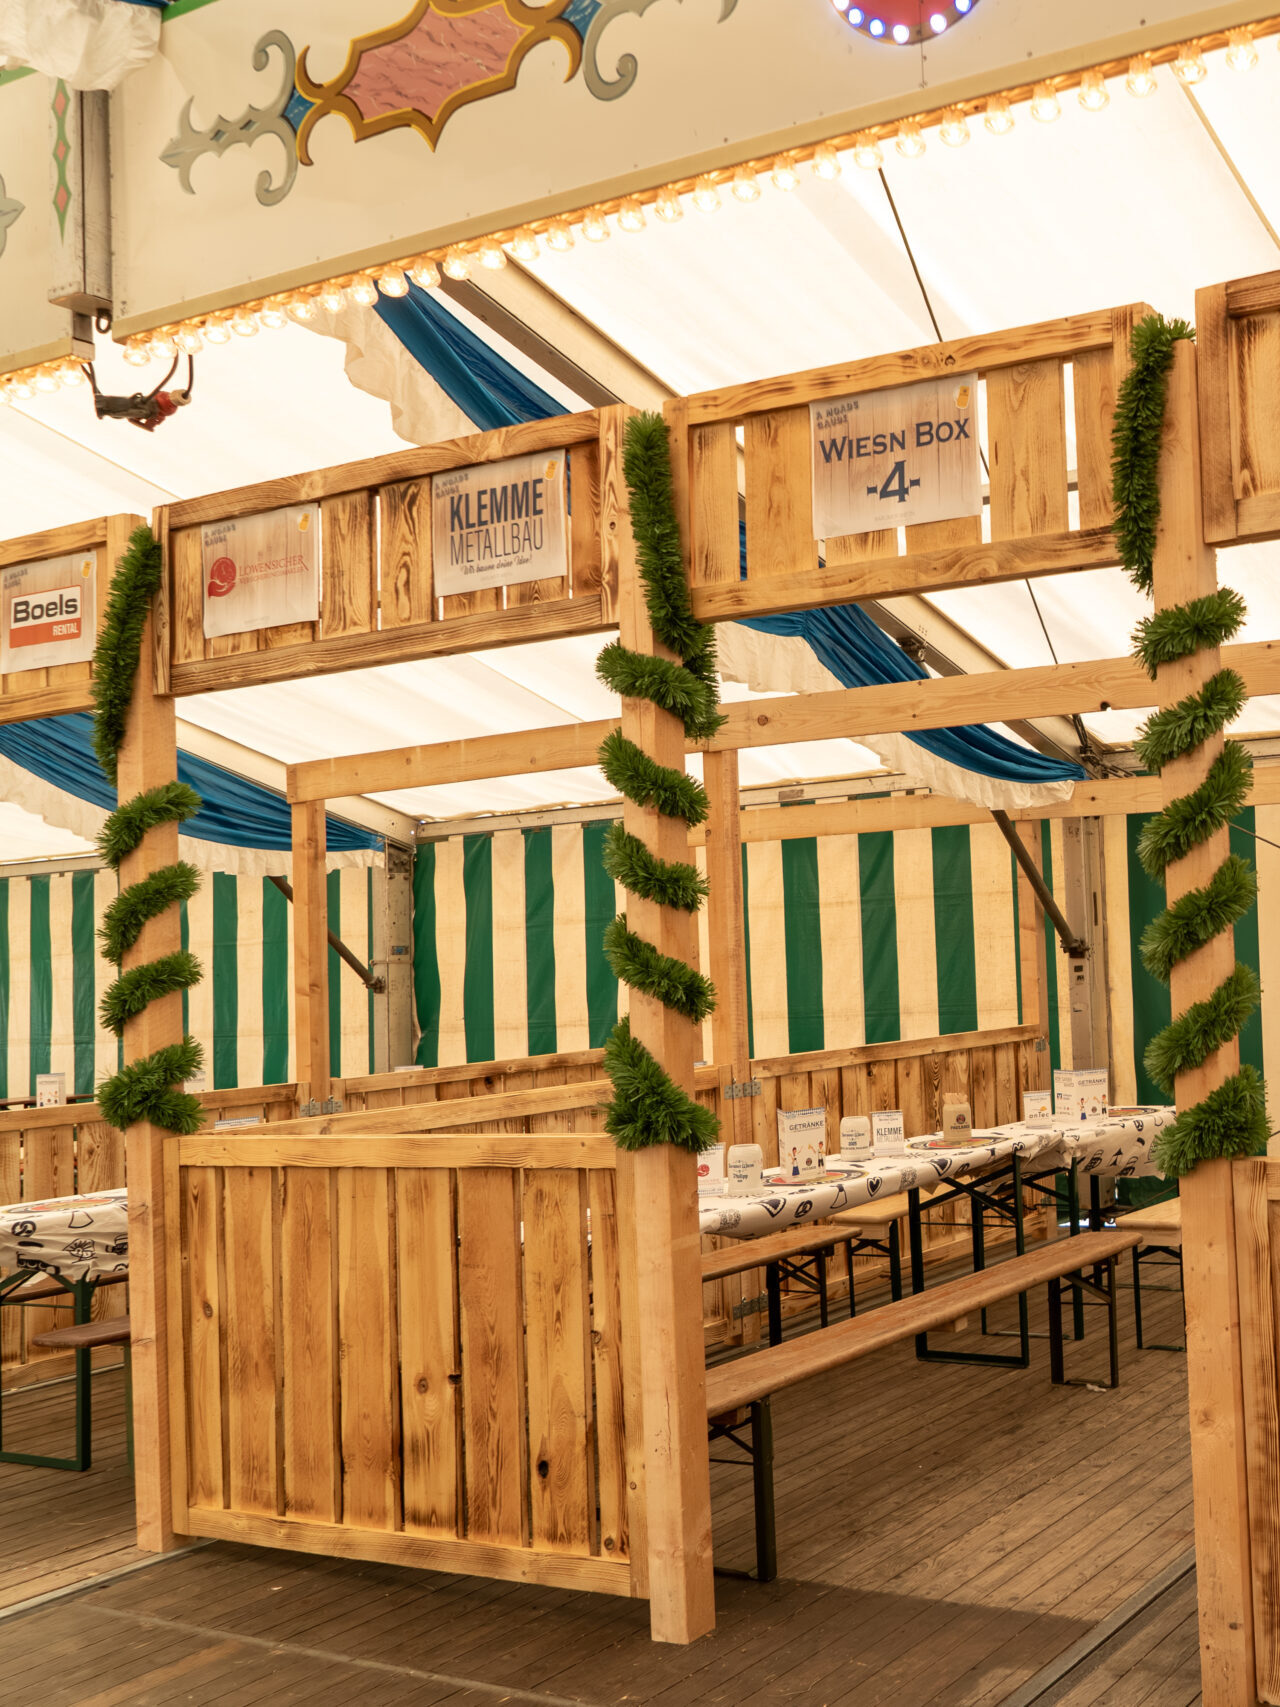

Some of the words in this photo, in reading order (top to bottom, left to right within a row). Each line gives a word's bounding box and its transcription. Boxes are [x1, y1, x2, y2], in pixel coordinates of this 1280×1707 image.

[819, 430, 906, 463] WIESN
[915, 417, 970, 448] BOX
[450, 478, 544, 533] KLEMME
[450, 517, 543, 567] METALLBAU
[13, 593, 78, 624] Boels
[52, 622, 79, 636] RENTAL
[877, 1126, 902, 1136] KLEMME
